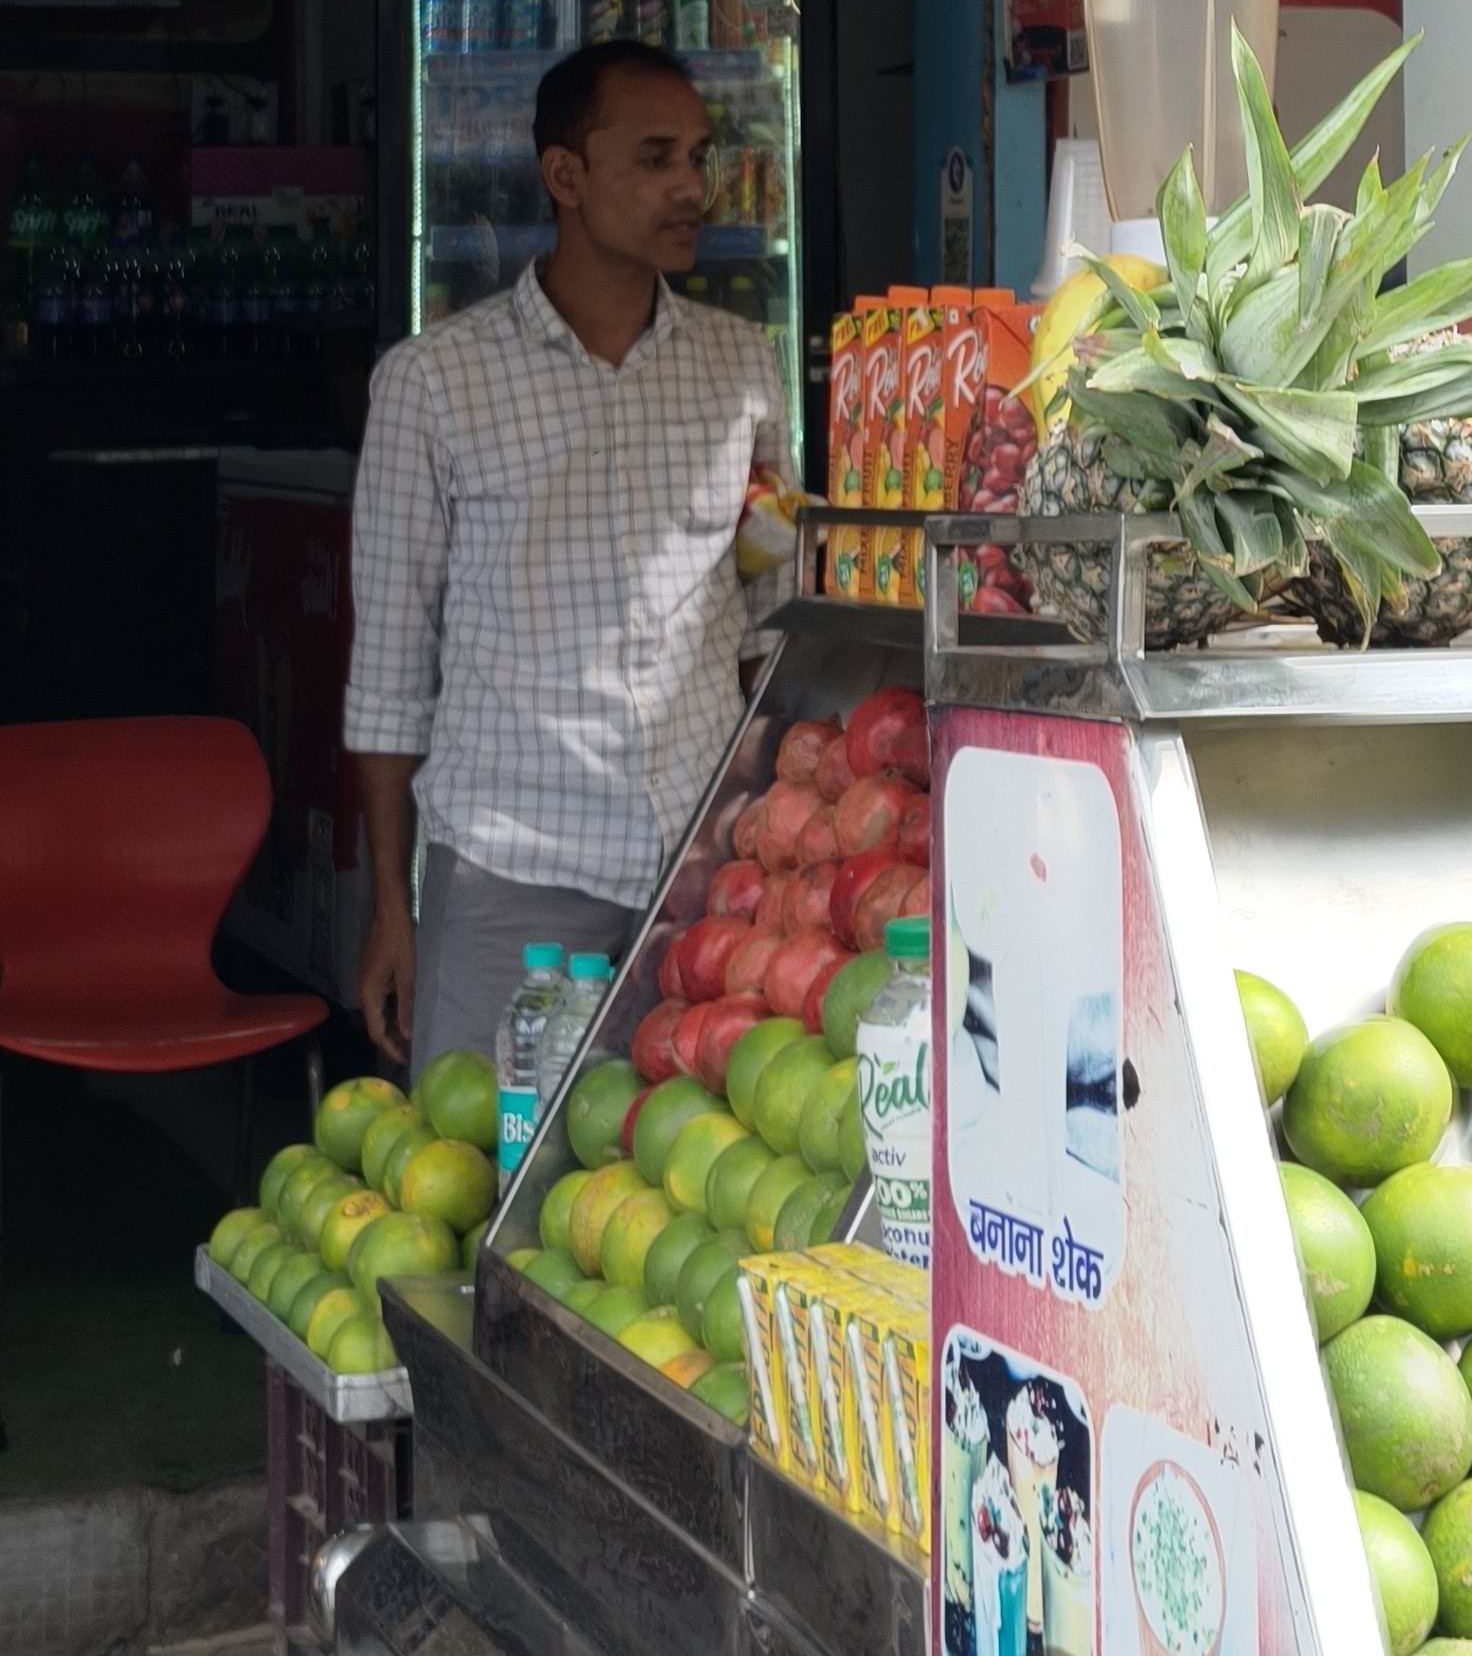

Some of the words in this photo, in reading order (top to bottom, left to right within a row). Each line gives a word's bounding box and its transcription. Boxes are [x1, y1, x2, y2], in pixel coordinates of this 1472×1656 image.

[871, 1145, 907, 1169] activ
[876, 1179, 927, 1209] 00%
[968, 1199, 1044, 1278] बनाना
[1051, 1216, 1103, 1301] शेक
